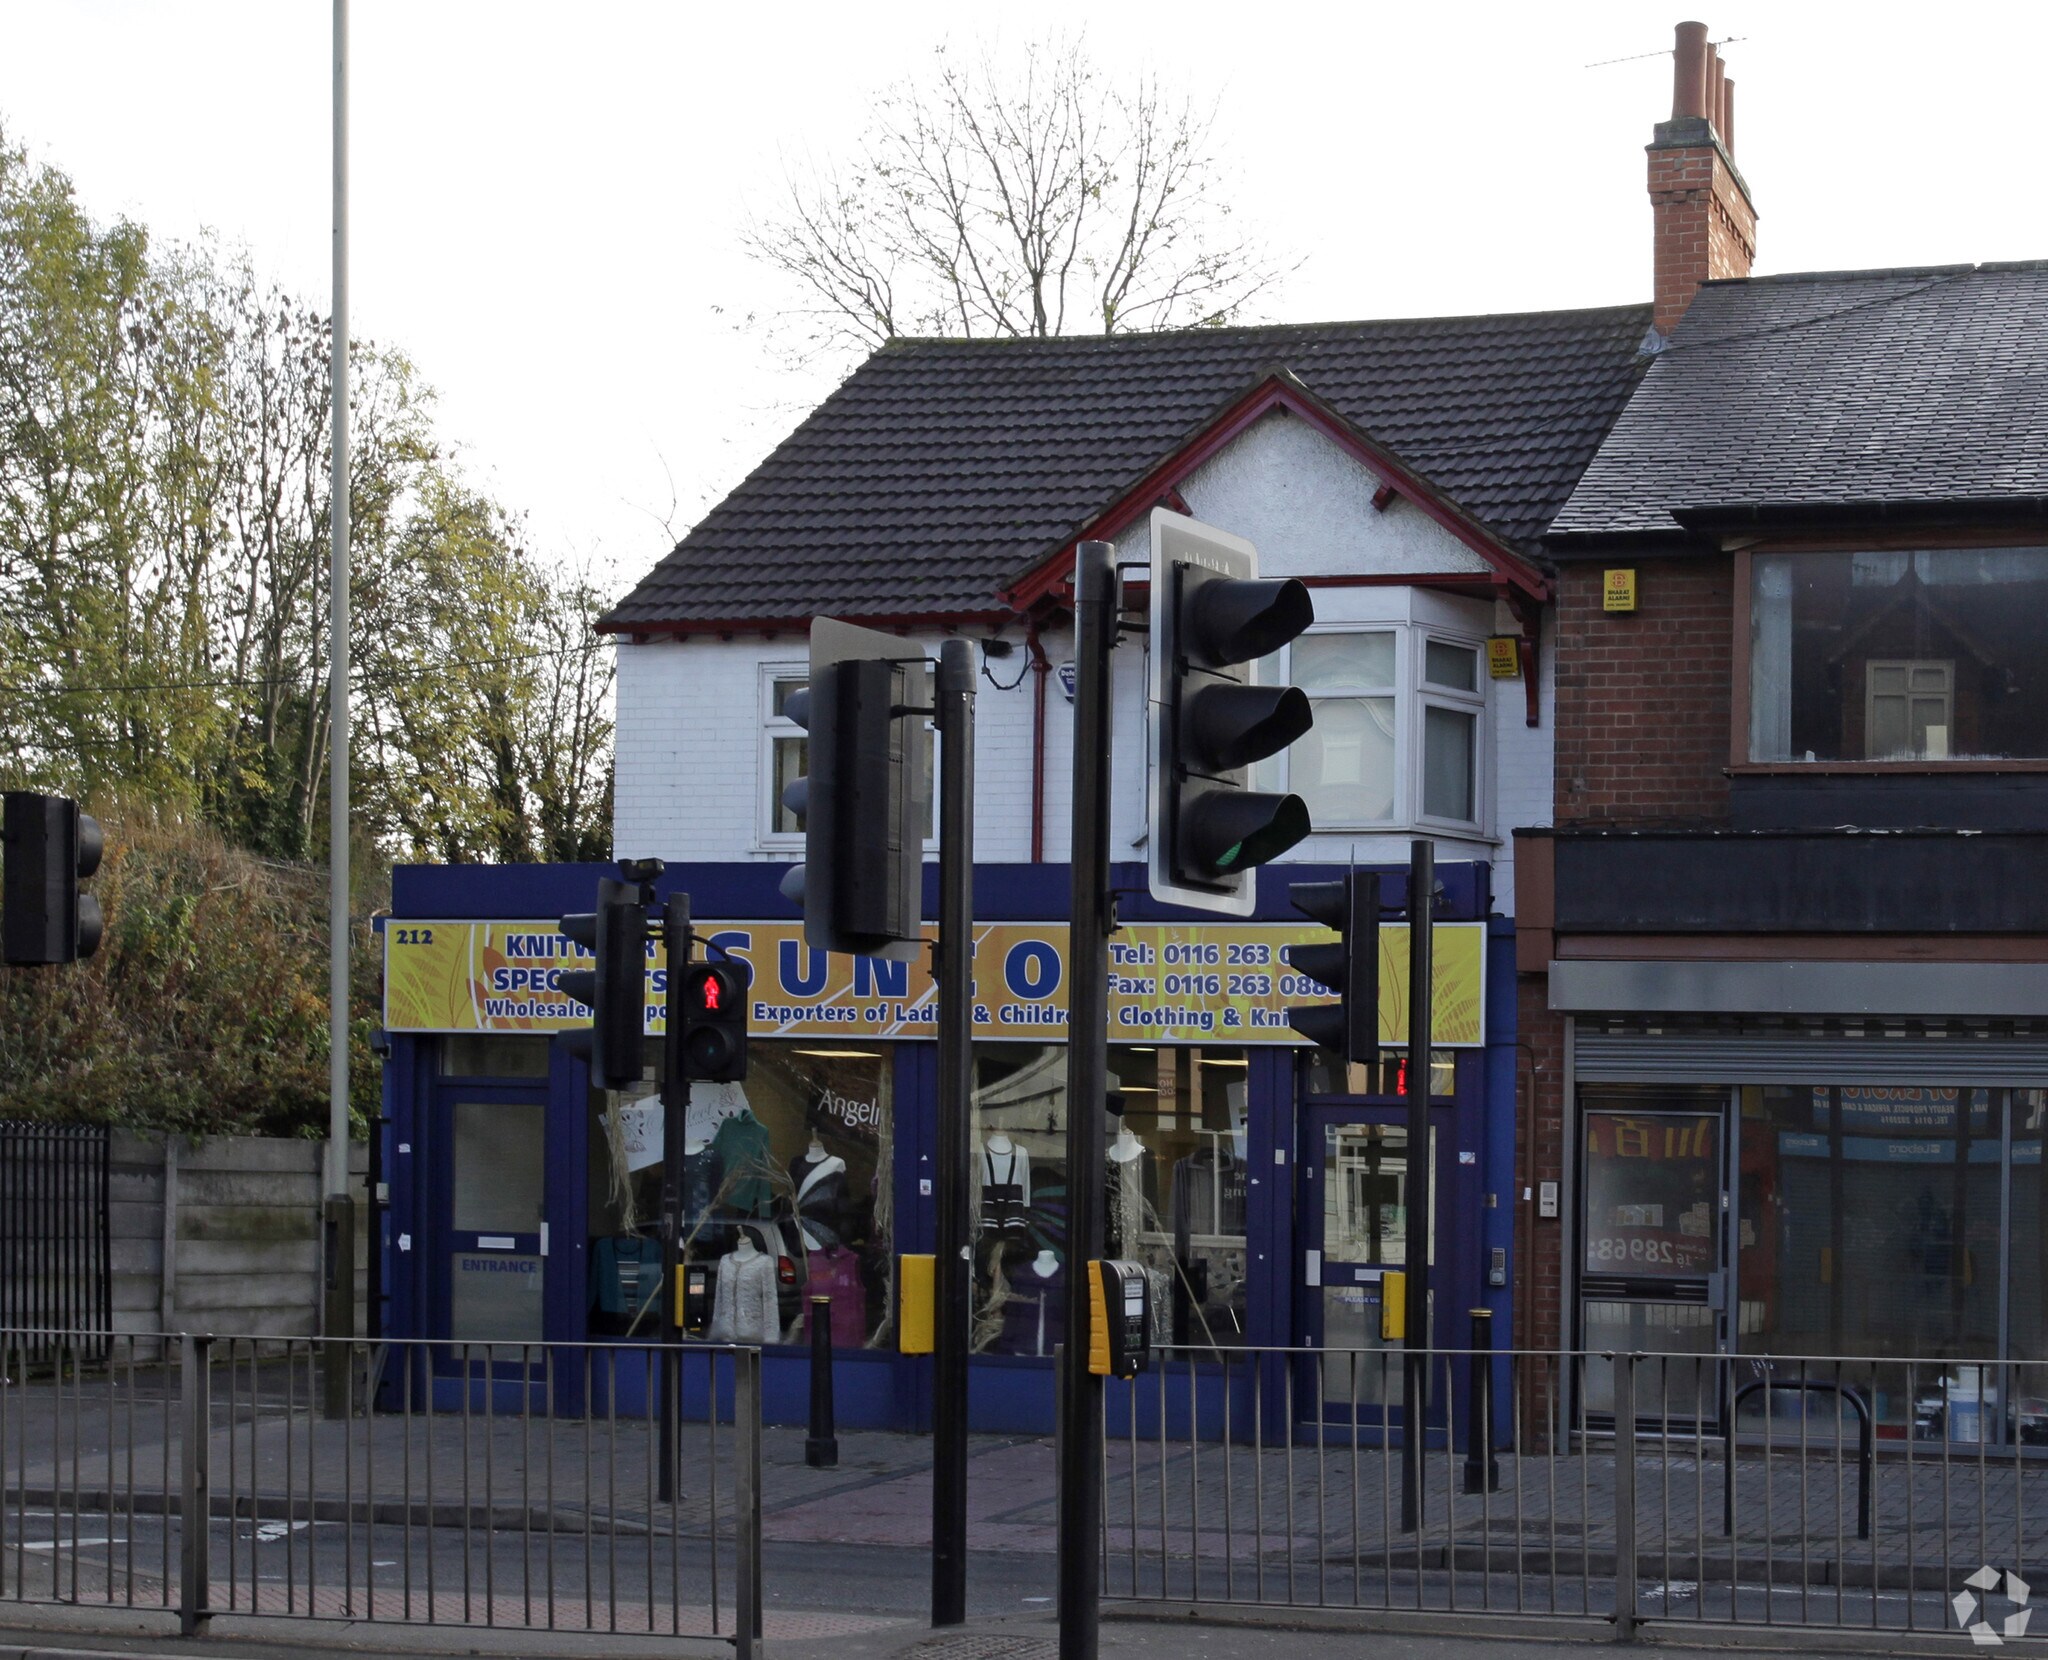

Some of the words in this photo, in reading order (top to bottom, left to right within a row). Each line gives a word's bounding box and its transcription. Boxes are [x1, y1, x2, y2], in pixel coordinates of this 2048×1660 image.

[396, 929, 433, 945] 212
[705, 931, 1063, 999] SUNO
[1110, 943, 1156, 965] Tel:
[1164, 943, 1220, 966] 0116
[1227, 943, 1272, 966] 263
[1107, 973, 1156, 996] Fax:
[1164, 974, 1221, 996] 0116
[1227, 974, 1272, 996] 263
[753, 1003, 857, 1025] Exporters
[865, 1002, 888, 1023] of
[895, 1003, 939, 1023] Ladi
[972, 1006, 991, 1024] &
[1118, 1006, 1215, 1031] Clothing
[1222, 1008, 1242, 1028] &
[461, 1258, 537, 1274] ENTRANCE
